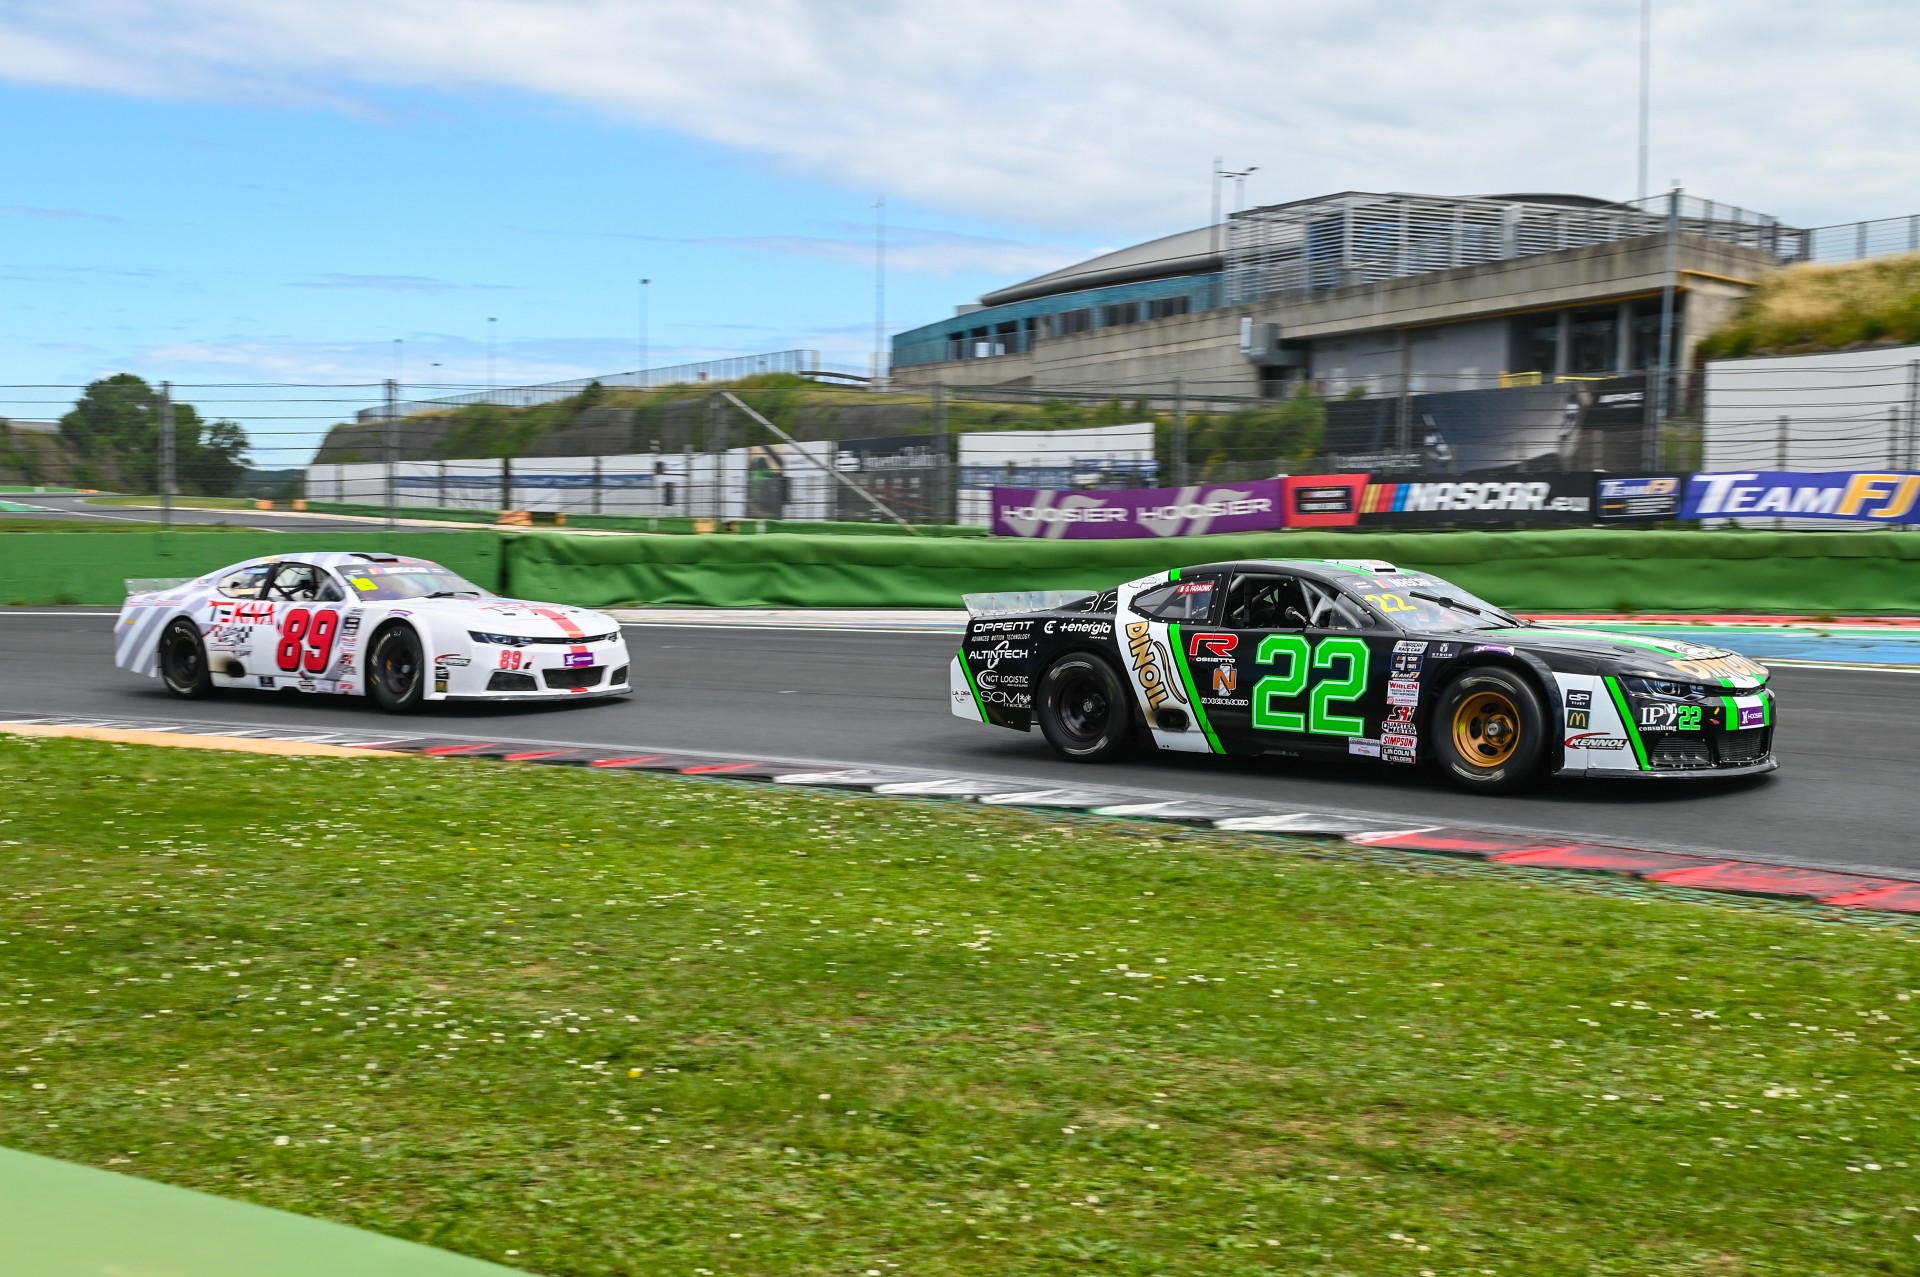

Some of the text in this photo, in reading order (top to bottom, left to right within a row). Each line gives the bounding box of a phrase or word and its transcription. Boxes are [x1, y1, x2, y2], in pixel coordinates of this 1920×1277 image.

[1364, 593, 1418, 613] 22
[973, 621, 1035, 633] OPPENT
[277, 608, 339, 675] 89
[500, 650, 522, 670] 89
[968, 649, 1029, 660] ALTINTECH
[1125, 620, 1170, 711] DINOIL
[1000, 675, 1029, 684] LOGISTIC
[1252, 633, 1371, 738] 22
[1390, 682, 1418, 690] WHELEN
[981, 691, 1020, 703] SCM
[1678, 706, 1702, 731] 22
[1383, 735, 1415, 747] SIMPSON
[1570, 739, 1625, 747] KENNOL
[1383, 748, 1410, 756] LINCOLN
